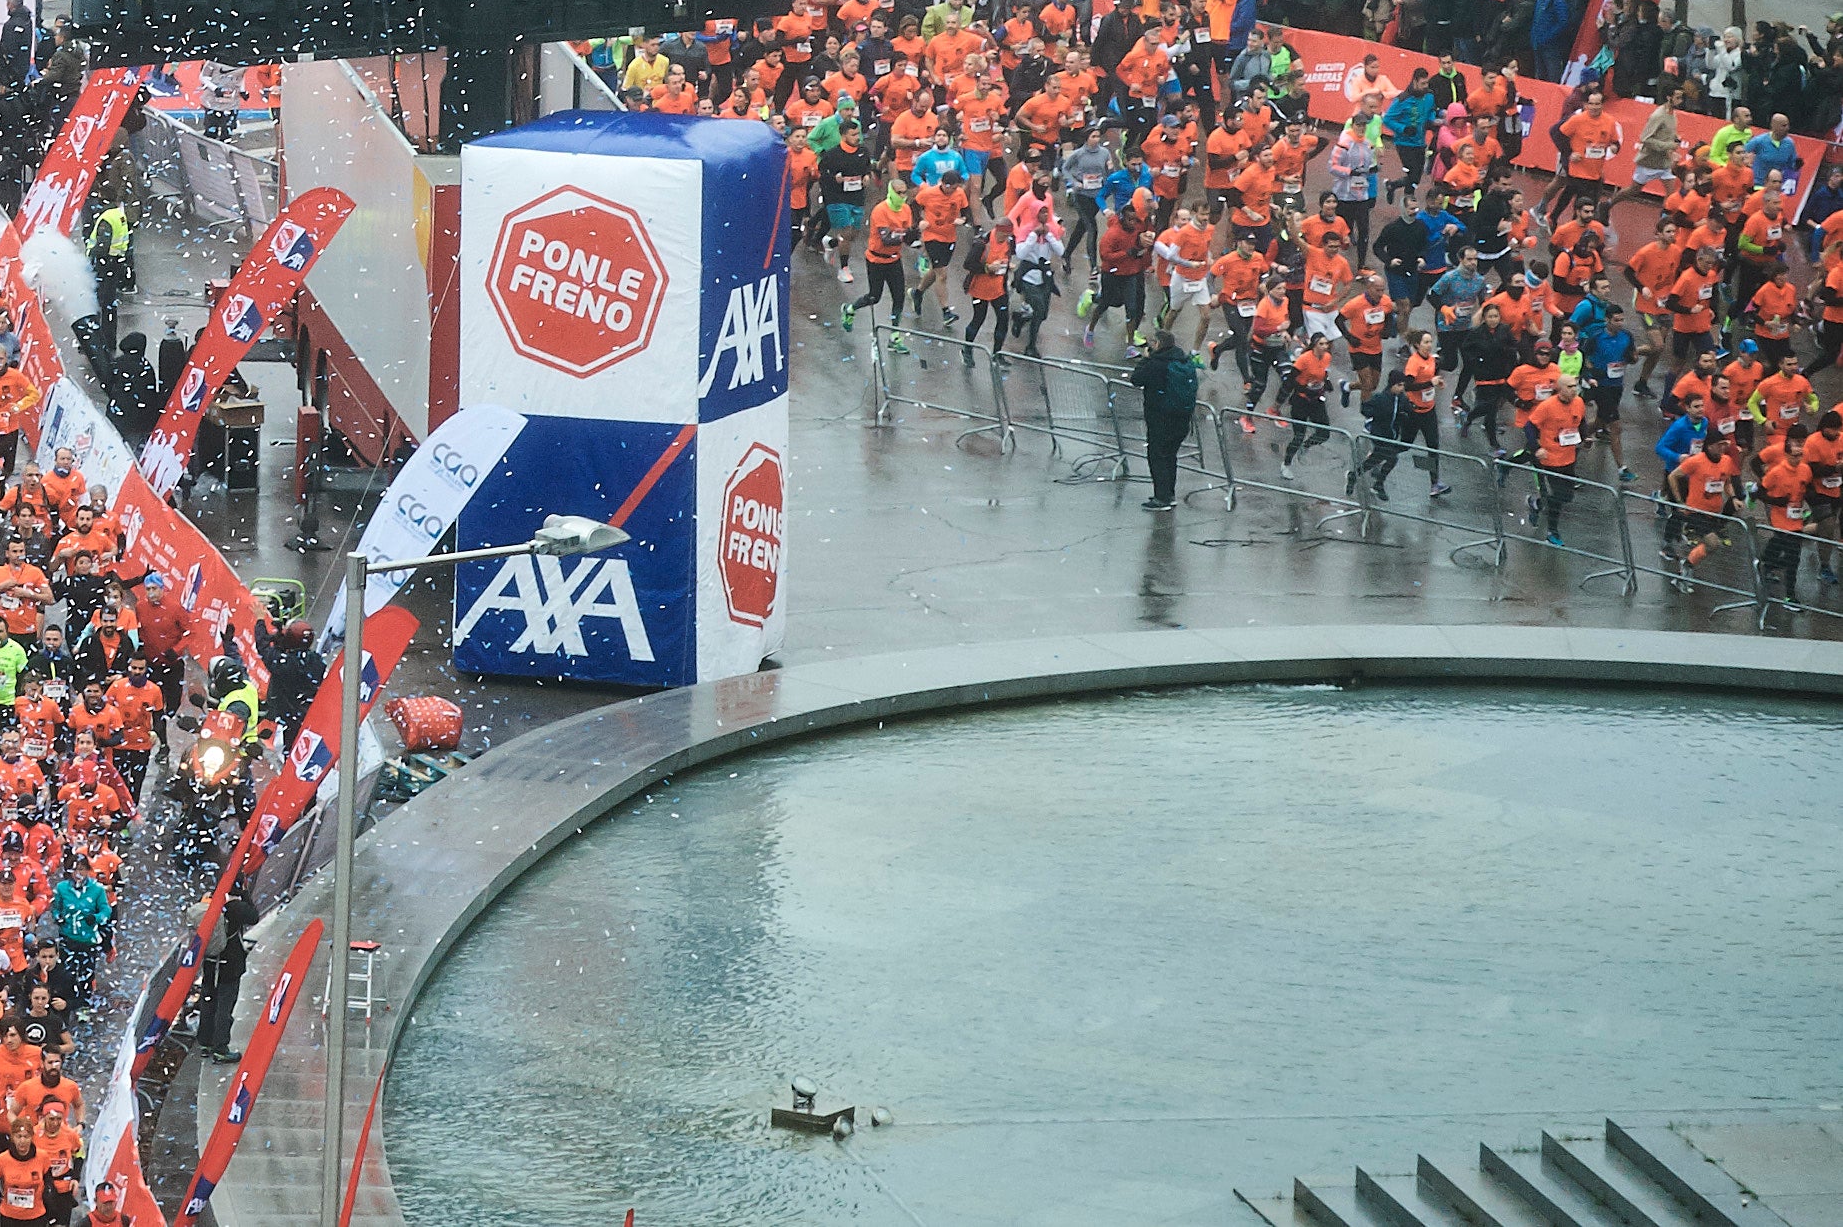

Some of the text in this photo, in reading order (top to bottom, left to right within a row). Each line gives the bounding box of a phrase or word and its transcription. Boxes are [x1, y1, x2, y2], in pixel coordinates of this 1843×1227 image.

[508, 264, 634, 334] FRENO
[518, 227, 646, 303] PONLE
[698, 273, 785, 400] AXA
[727, 530, 781, 574] FREN
[454, 553, 656, 664] AXA
